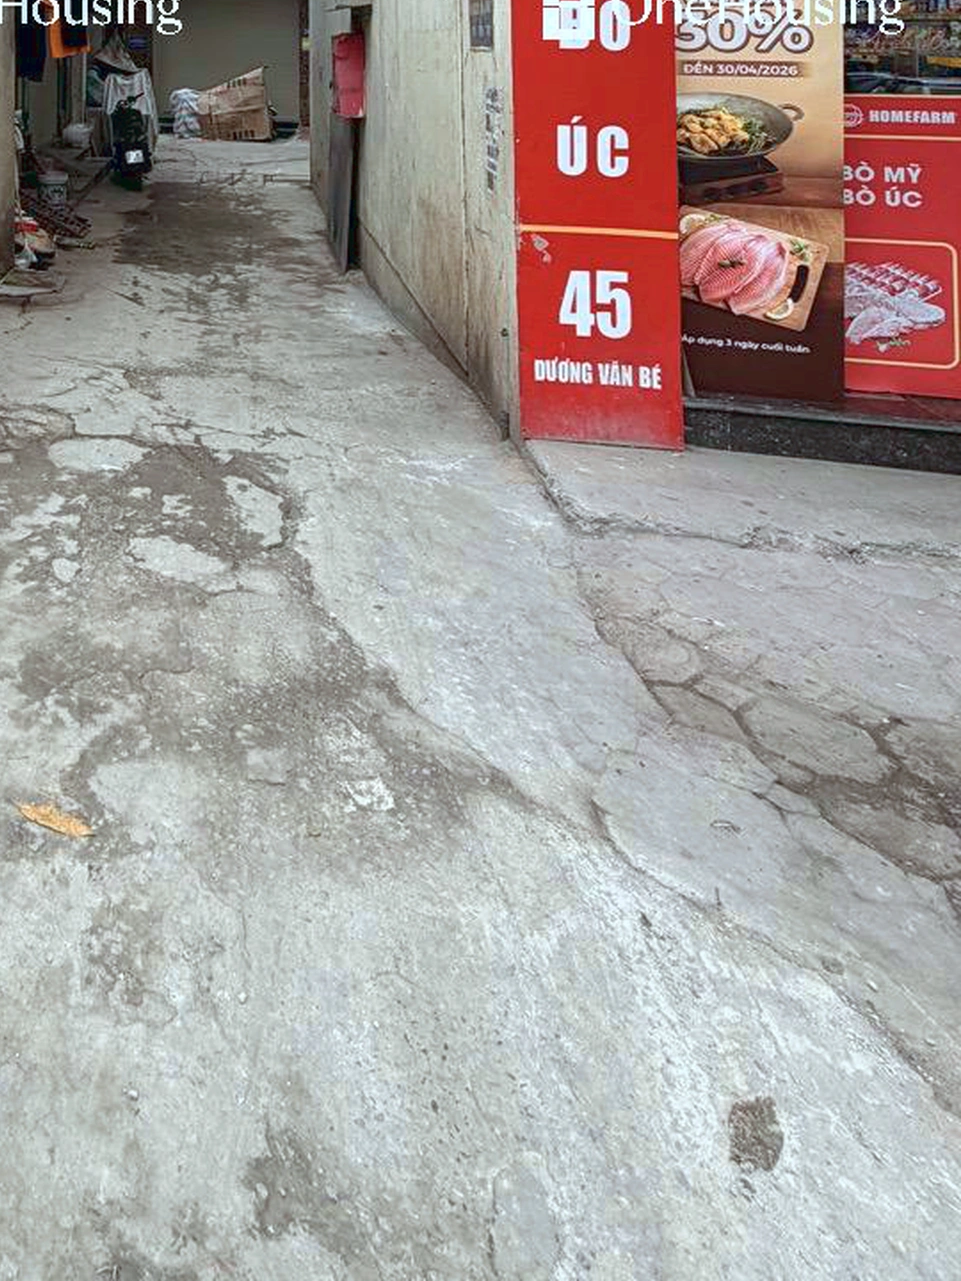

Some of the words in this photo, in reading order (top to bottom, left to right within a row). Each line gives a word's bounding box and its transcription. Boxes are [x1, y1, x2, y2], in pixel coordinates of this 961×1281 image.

[683, 61, 713, 74] ĐẾN
[716, 63, 798, 76] 30/04/2026
[869, 110, 956, 124] HOMEFARM
[556, 116, 629, 178] ÚC
[843, 161, 875, 182] BÒ
[884, 163, 921, 183] MỸ
[843, 185, 876, 205] BÒ
[885, 186, 922, 207] ÚC
[559, 269, 632, 339] 45
[725, 338, 732, 346] 3
[534, 356, 593, 384] DƯƠNG
[598, 361, 633, 387] VĂN
[639, 363, 662, 389] BÉ
